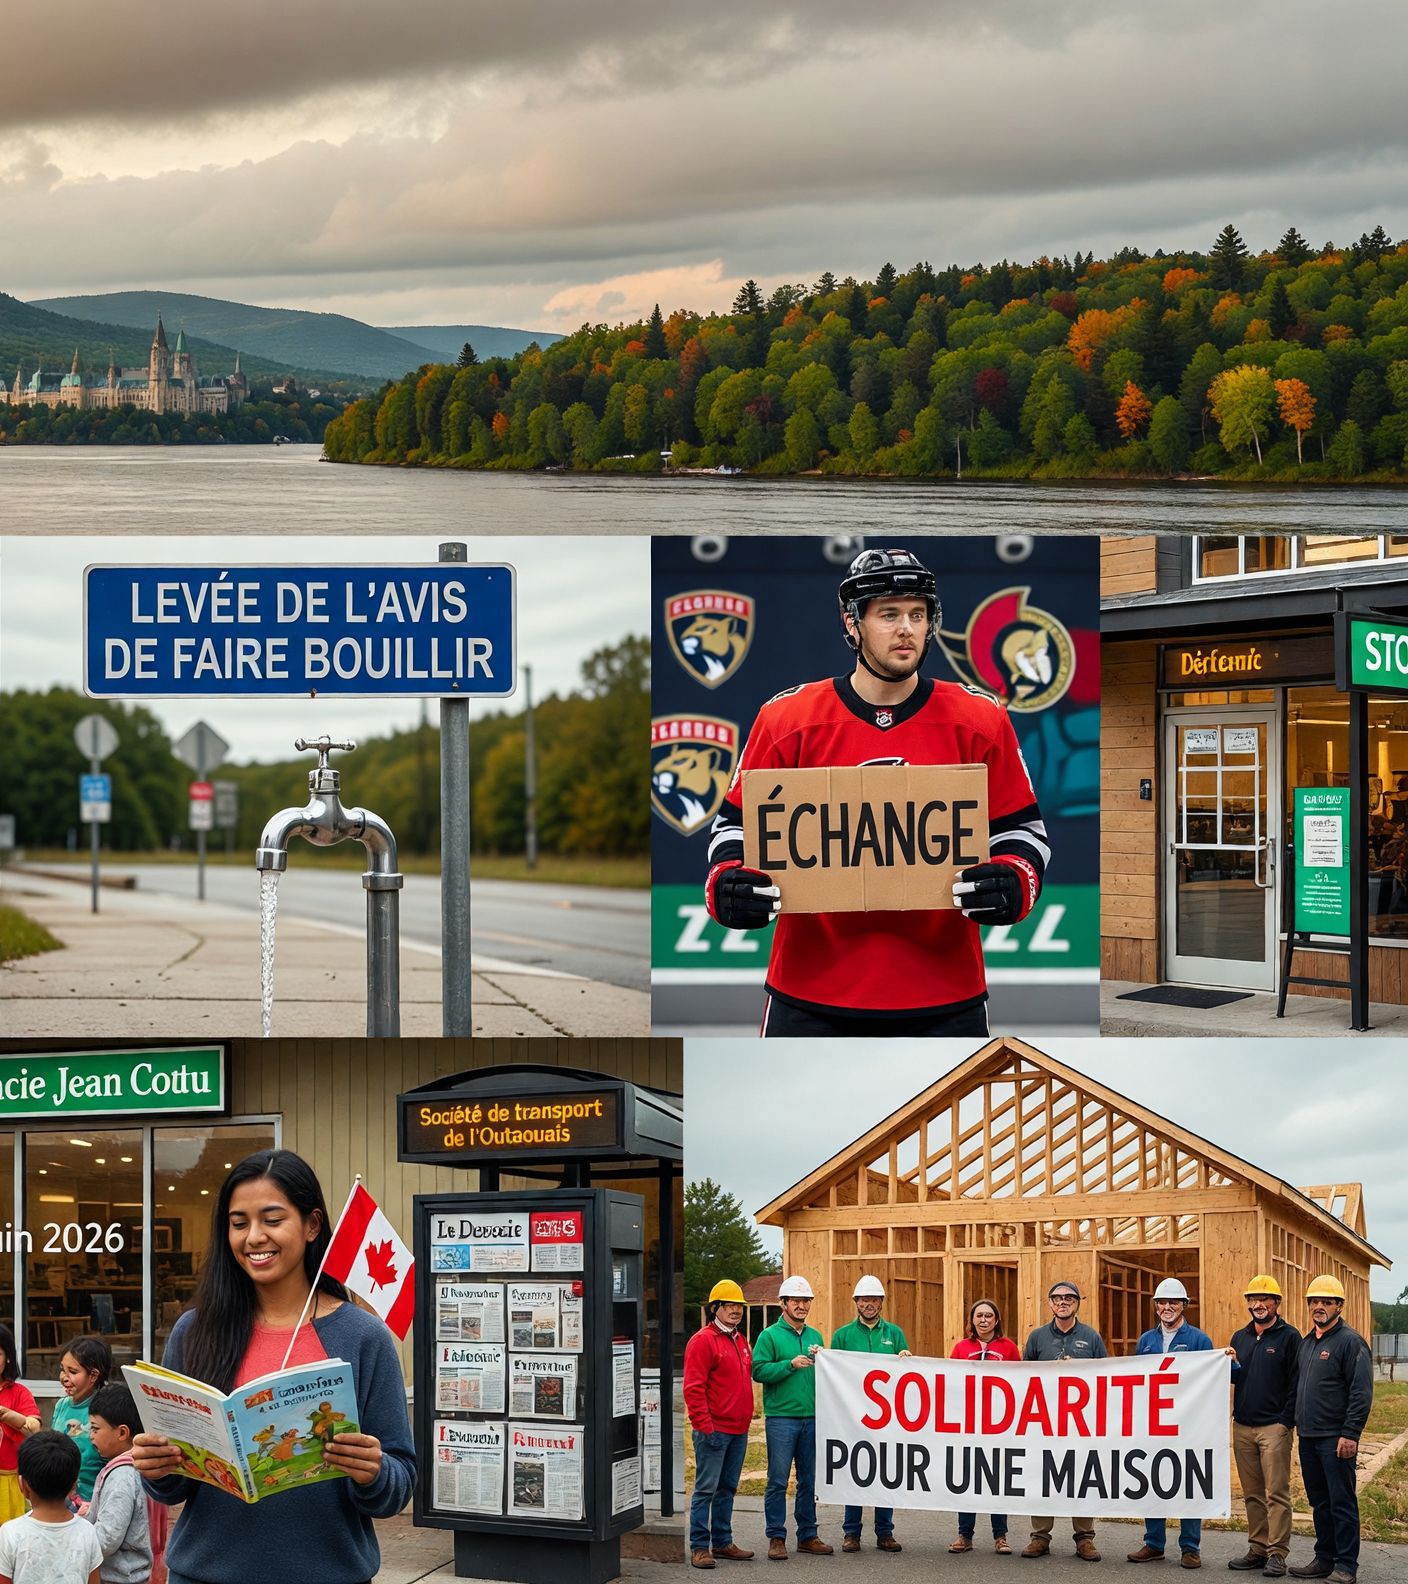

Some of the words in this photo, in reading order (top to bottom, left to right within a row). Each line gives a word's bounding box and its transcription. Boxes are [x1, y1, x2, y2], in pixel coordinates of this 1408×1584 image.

[131, 571, 261, 624] LEVÉE
[277, 581, 329, 624] DE
[346, 580, 468, 624] L'AVIS
[105, 637, 158, 680] DE
[174, 637, 289, 680] FAIRE
[304, 636, 494, 680] BOUILLIR
[757, 784, 980, 871] ÉCHANGE
[52, 1066, 122, 1107] Jean
[420, 1104, 482, 1127] Société
[488, 1104, 509, 1123] de
[515, 1099, 603, 1124] transport
[444, 1128, 465, 1147] de
[470, 1124, 571, 1147] l'Outaouais
[860, 1357, 1180, 1437] SOLIDARITÉ
[825, 1438, 931, 1492] POUR
[945, 1445, 1026, 1498] UNE
[1042, 1448, 1214, 1501] MAISON
